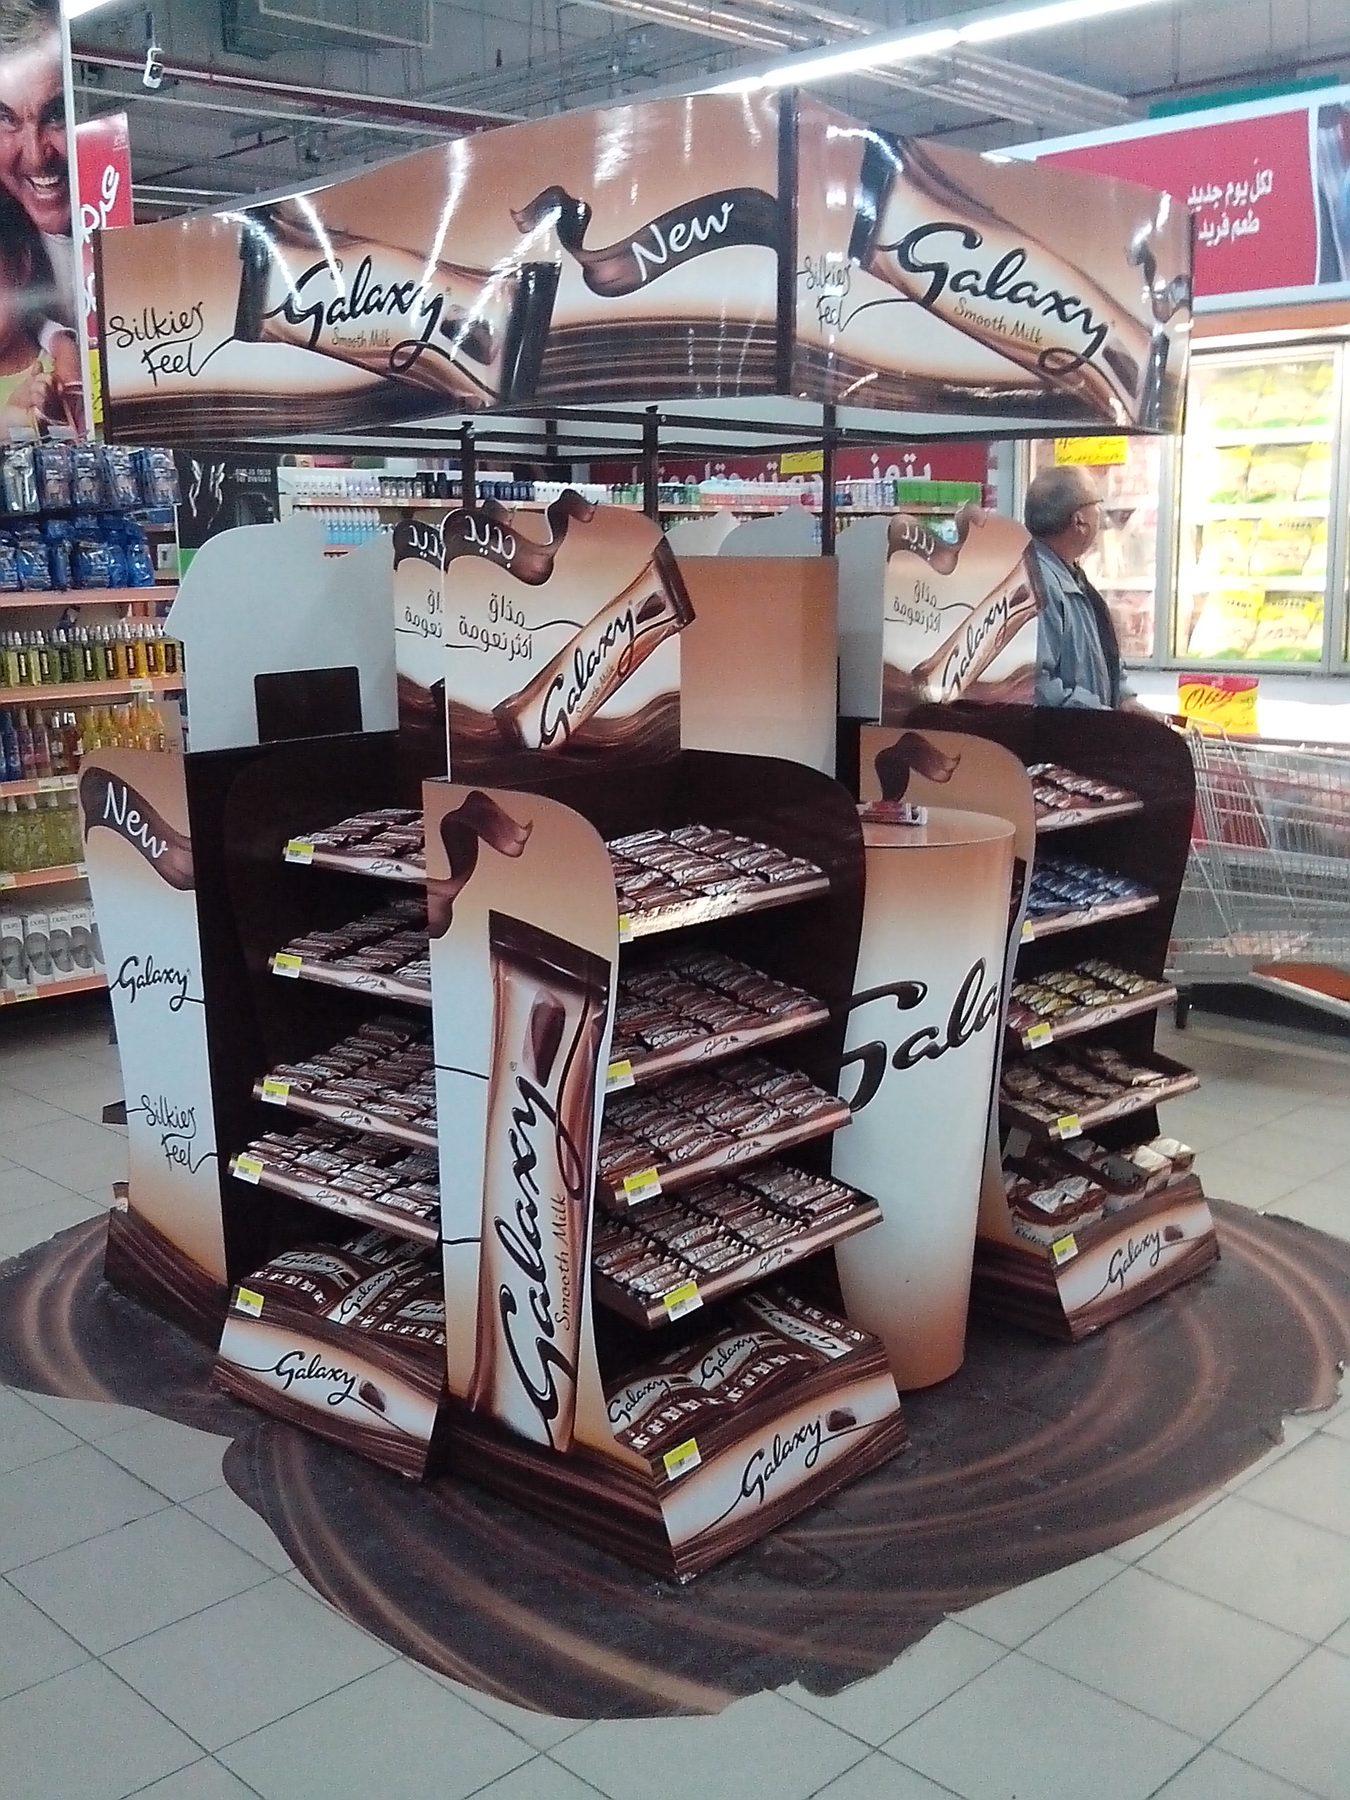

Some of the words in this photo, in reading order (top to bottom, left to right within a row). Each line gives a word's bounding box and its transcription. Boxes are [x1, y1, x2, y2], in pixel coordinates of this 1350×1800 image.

[1187, 183, 1224, 212] جديد
[1225, 180, 1250, 207] يوم
[631, 201, 735, 282] New
[1198, 211, 1230, 247] فريد
[1231, 208, 1261, 242] طعم
[270, 254, 445, 374] Galaxy
[897, 221, 1109, 376] Galaxy
[953, 296, 1009, 335] Smooth
[1009, 319, 1044, 344] Milk
[105, 301, 204, 349] Silkier
[331, 326, 368, 348] Smooth
[370, 329, 392, 347] Milk
[141, 341, 216, 387] Feel
[464, 515, 516, 569] جديد
[902, 521, 935, 561] جديد
[488, 592, 526, 628] مذاق
[893, 596, 925, 626] نعومة
[913, 579, 938, 608] مذاق
[459, 614, 508, 653] نعومة
[508, 633, 533, 662] أكثر
[941, 595, 1009, 695] Galaxy
[539, 605, 637, 748] Galaxy
[102, 780, 169, 860] New
[115, 955, 191, 1012] Galaxy
[140, 1094, 197, 1138] Silkier
[161, 1133, 203, 1175] Feel
[549, 1193, 568, 1243] Milk
[281, 1251, 344, 1276] Galaxy
[495, 1073, 585, 1451] Galaxy
[1106, 1230, 1161, 1290] Galaxy
[340, 1269, 399, 1315] Galaxy
[551, 1242, 574, 1333] Smooth
[271, 1349, 358, 1406] Galaxy
[700, 1335, 762, 1387] Galaxy
[606, 1376, 673, 1424] Galaxy
[739, 1414, 822, 1504] Galaxy
